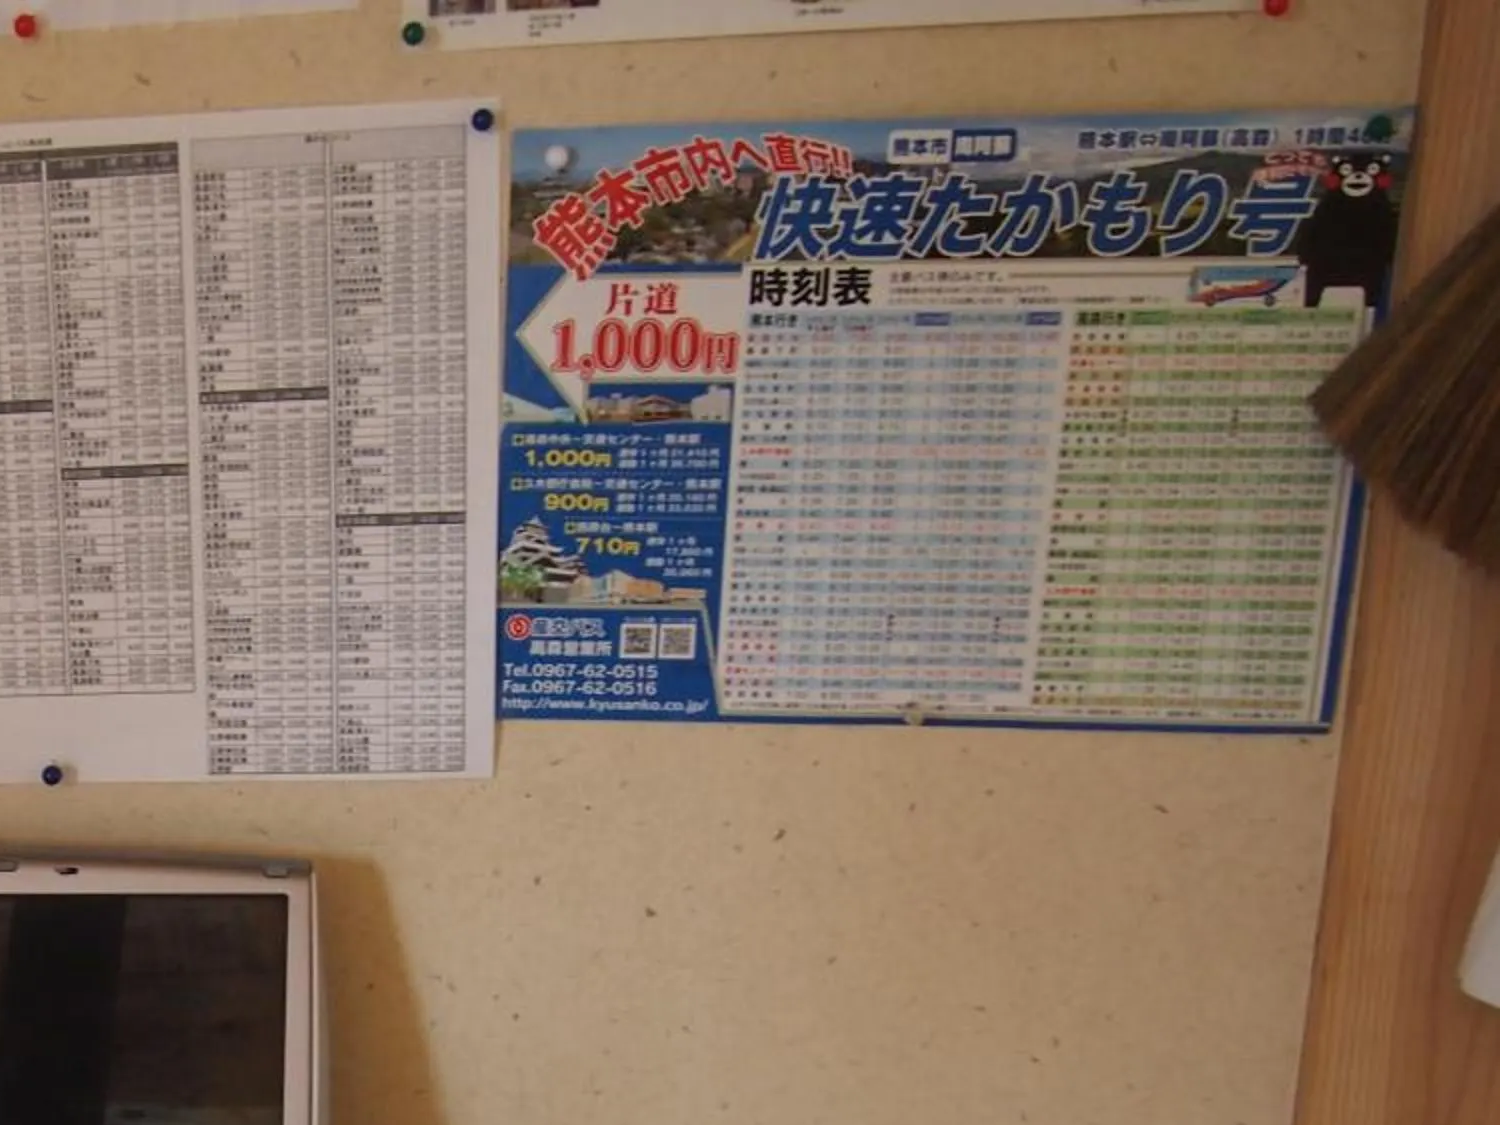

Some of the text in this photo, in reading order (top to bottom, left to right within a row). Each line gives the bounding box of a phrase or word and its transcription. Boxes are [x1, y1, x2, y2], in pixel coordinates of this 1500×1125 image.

[756, 172, 1318, 260] 快速たかもり号
[605, 283, 679, 316] 片道
[749, 267, 873, 308] 時刻表
[551, 317, 740, 382] 1,000円
[544, 494, 610, 511] 900円
[576, 537, 641, 555] 710円
